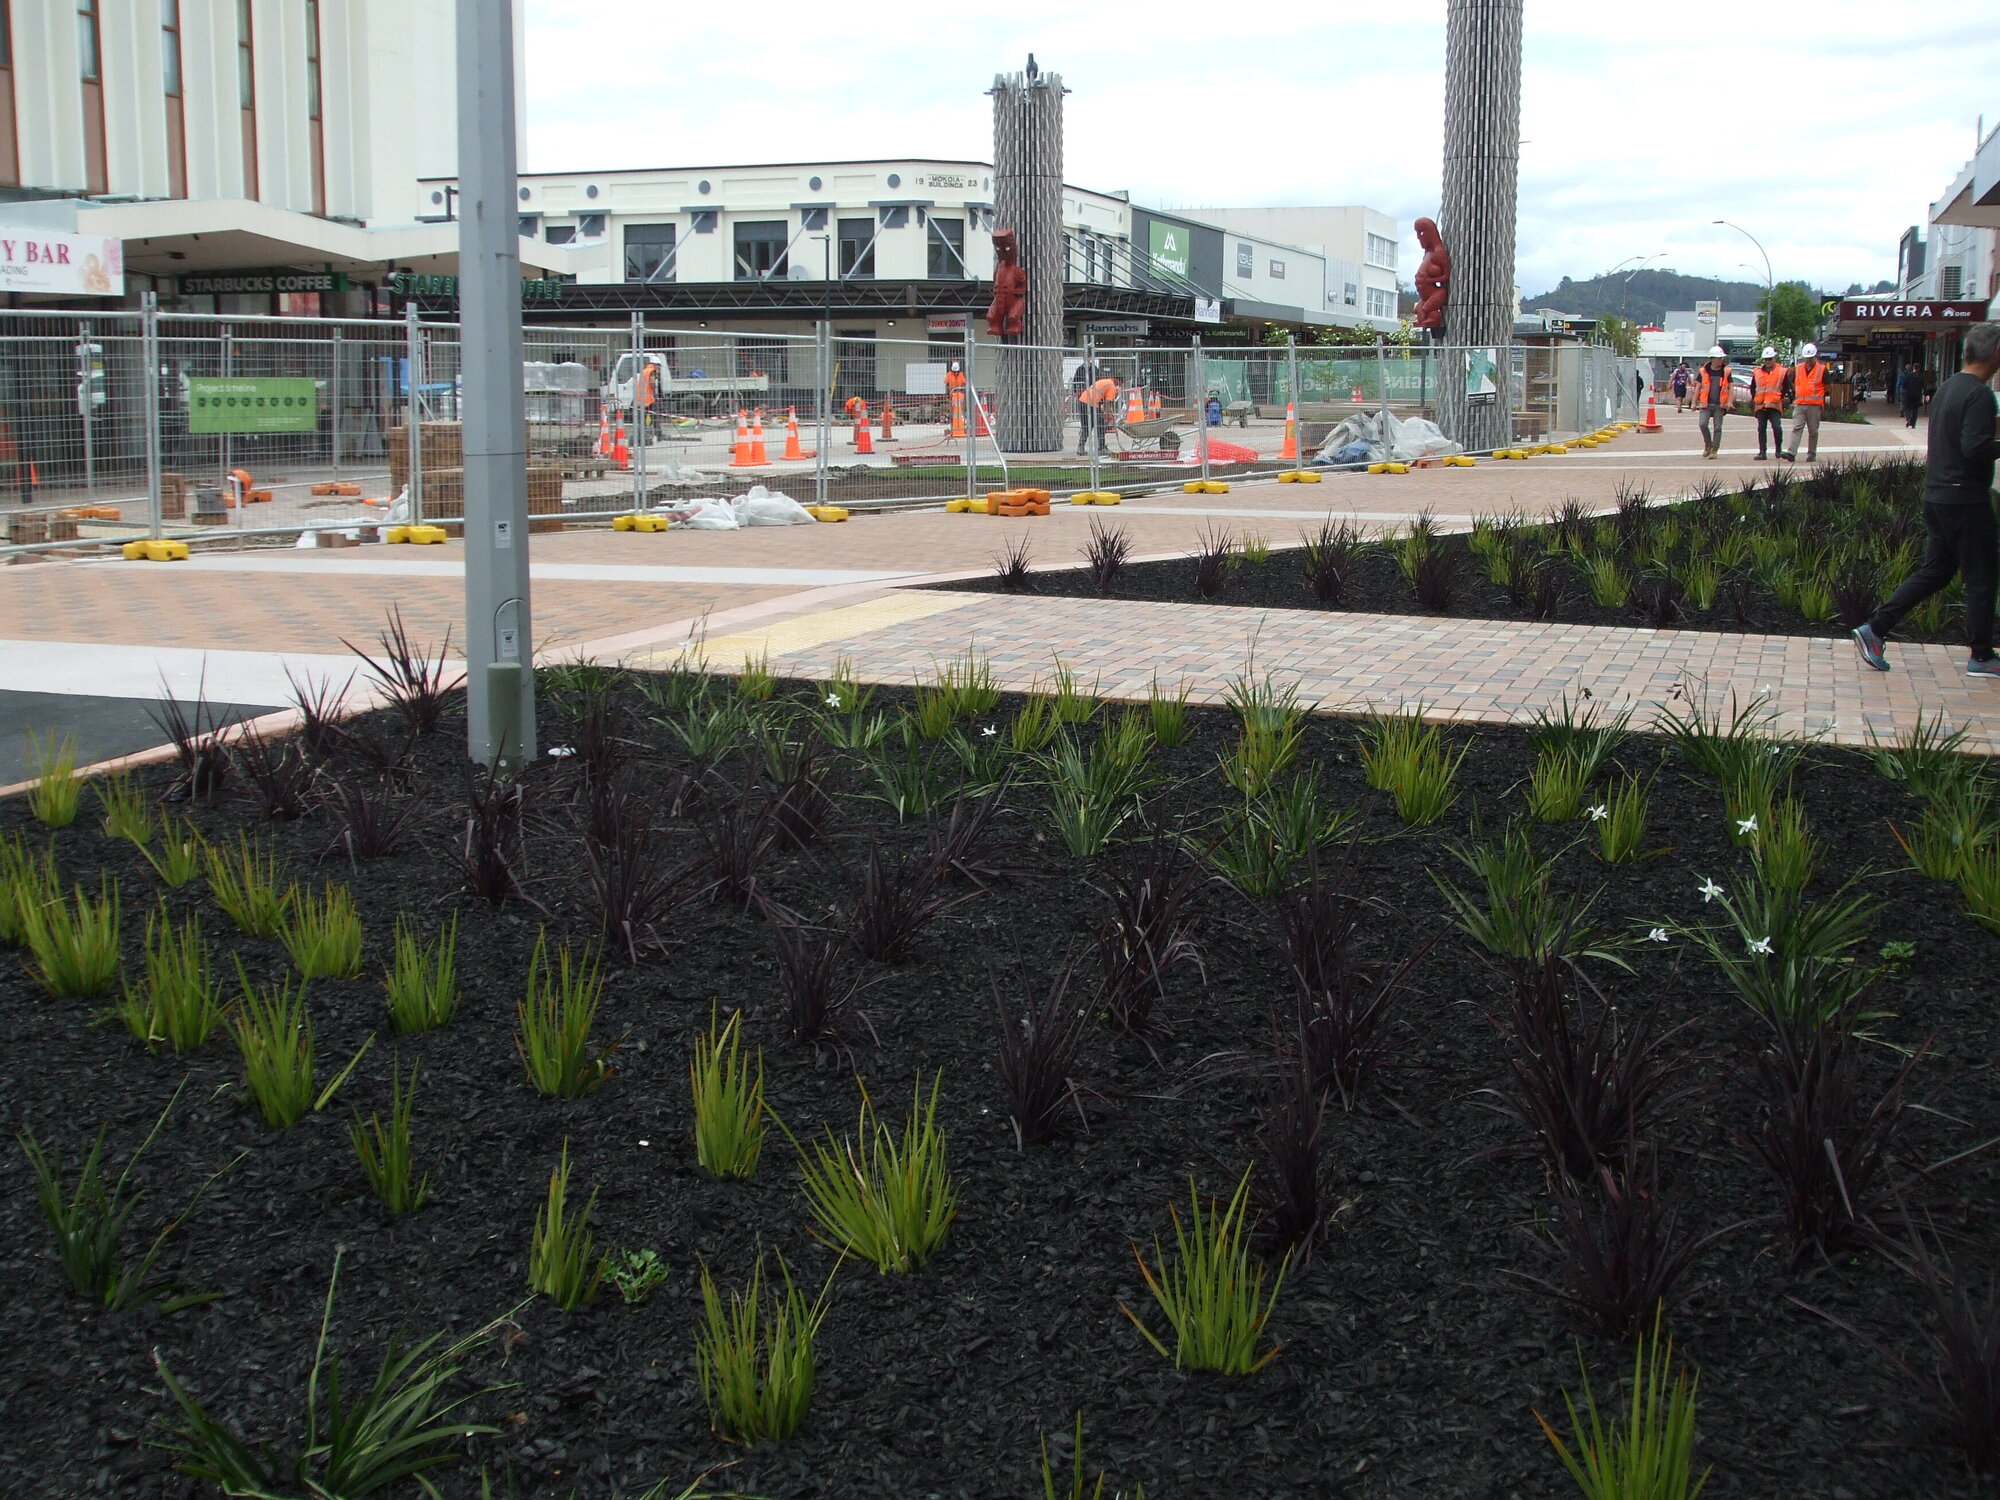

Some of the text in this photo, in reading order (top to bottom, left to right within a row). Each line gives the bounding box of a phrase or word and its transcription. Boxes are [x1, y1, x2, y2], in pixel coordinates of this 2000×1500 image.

[915, 177, 924, 185] 19
[967, 179, 978, 187] 23
[26, 241, 71, 264] BAR
[184, 275, 332, 292] STARBUCKS COFFEE
[393, 272, 562, 300] STARB FFEE
[1856, 305, 1933, 317] RIVERA
[1086, 323, 1139, 332] Hannahs
